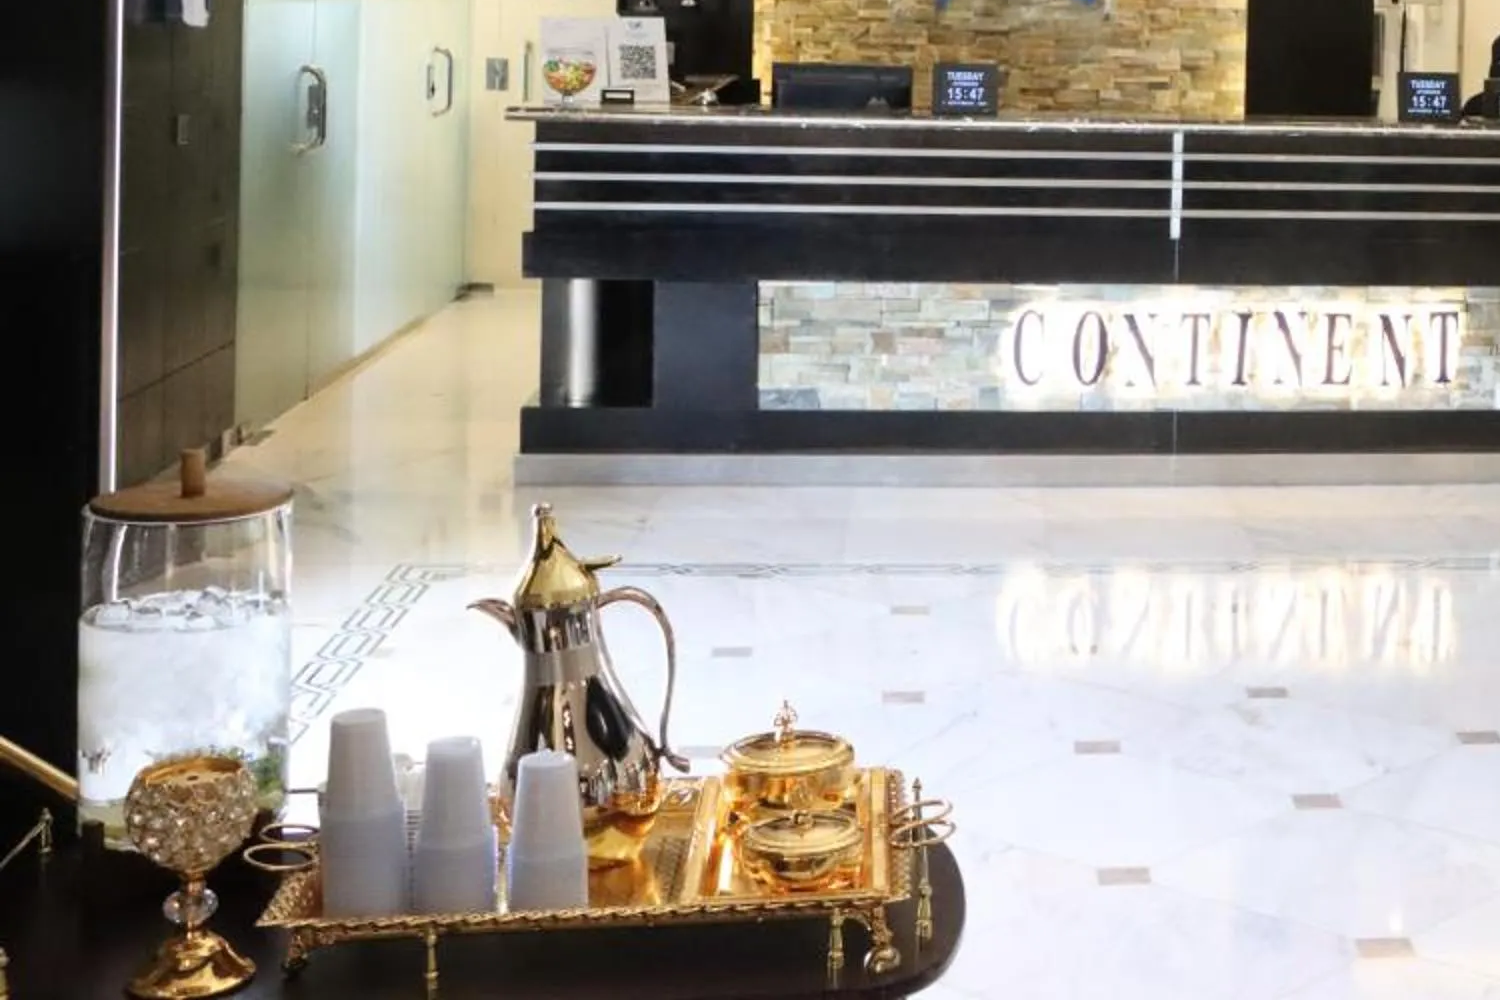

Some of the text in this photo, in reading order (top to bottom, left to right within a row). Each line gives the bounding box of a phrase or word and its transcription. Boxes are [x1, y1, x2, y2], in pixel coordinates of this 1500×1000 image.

[946, 87, 985, 101] 15:47
[1412, 95, 1447, 109] 15:47
[1012, 308, 1460, 389] CONTINENT
